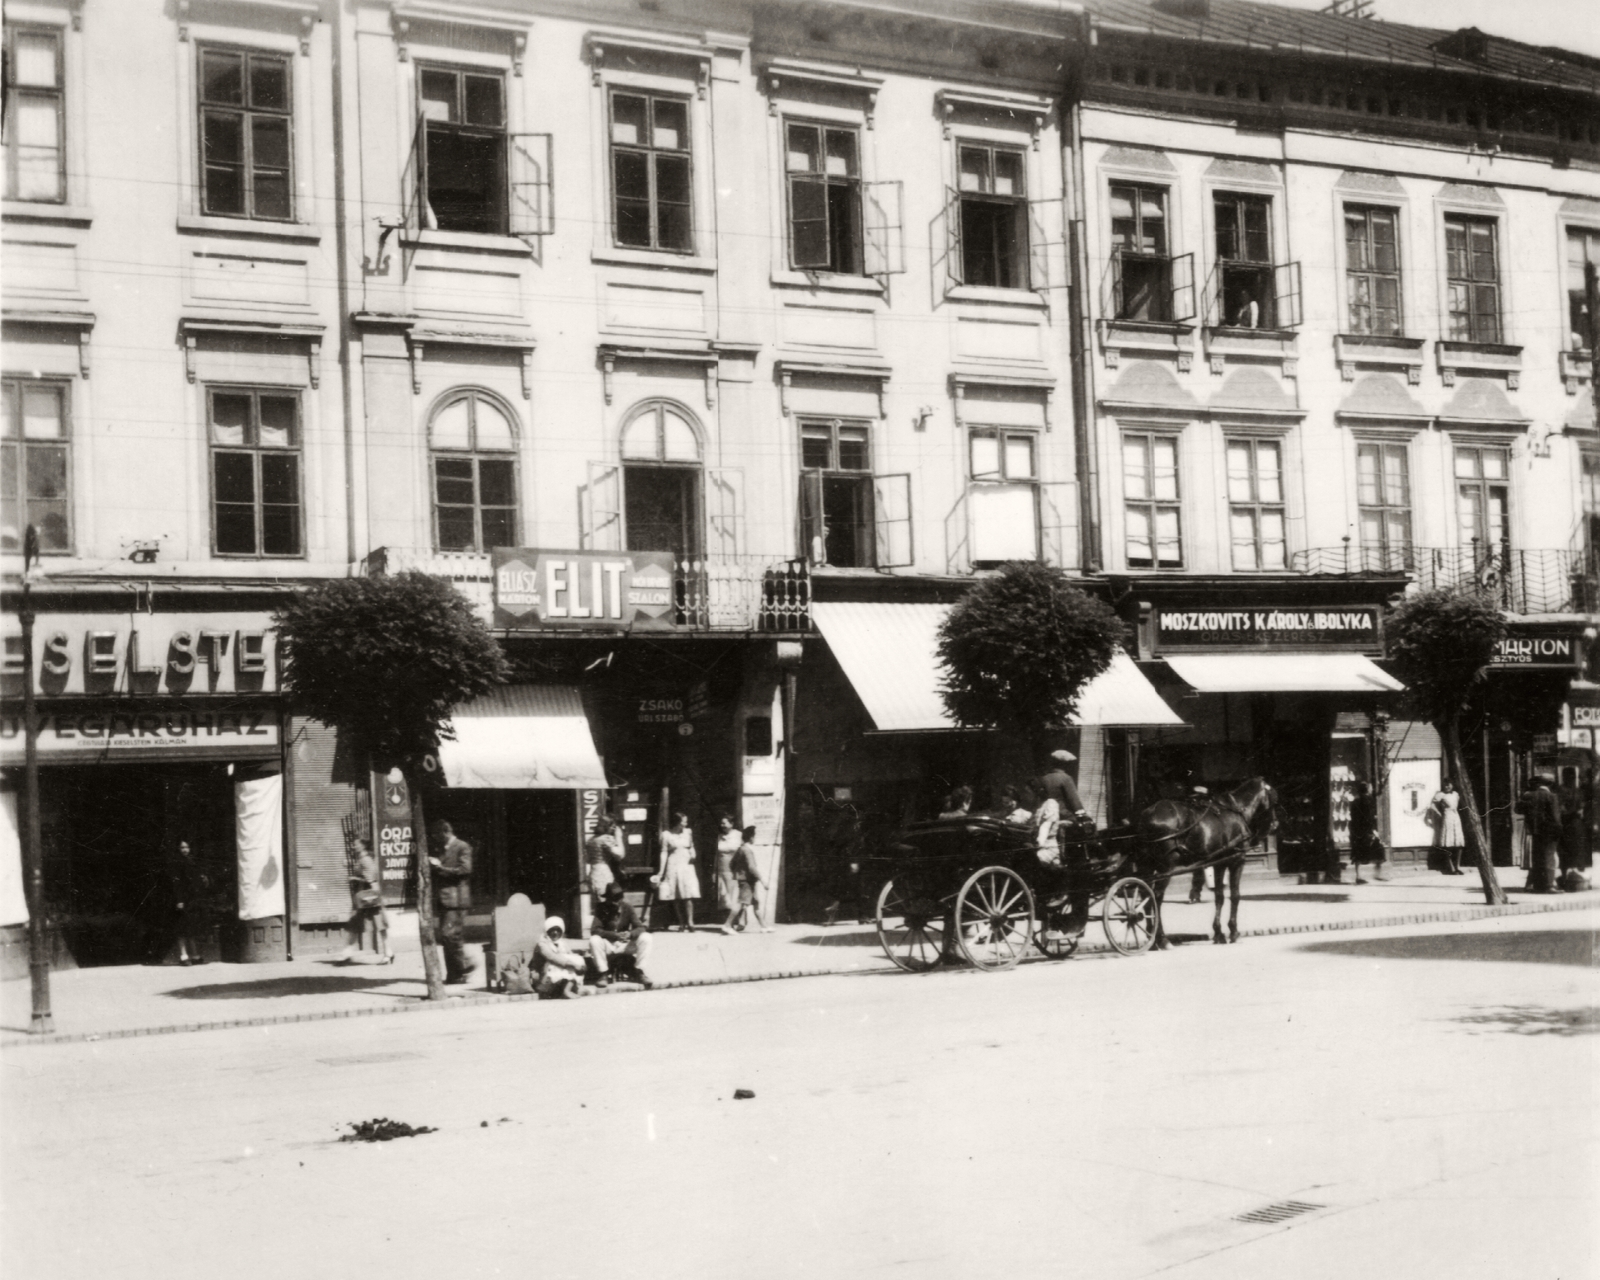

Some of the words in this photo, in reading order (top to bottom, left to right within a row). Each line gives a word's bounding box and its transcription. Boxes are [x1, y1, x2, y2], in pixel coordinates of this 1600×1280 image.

[628, 592, 669, 604] SZALON
[1161, 613, 1250, 630] MOSZKOVITS
[1255, 610, 1309, 630] KÁROLY
[1314, 613, 1372, 629] IBOLYKA
[0, 629, 280, 675] ESELSTE
[1574, 707, 1600, 720] FOT
[380, 823, 412, 841] ÓRA
